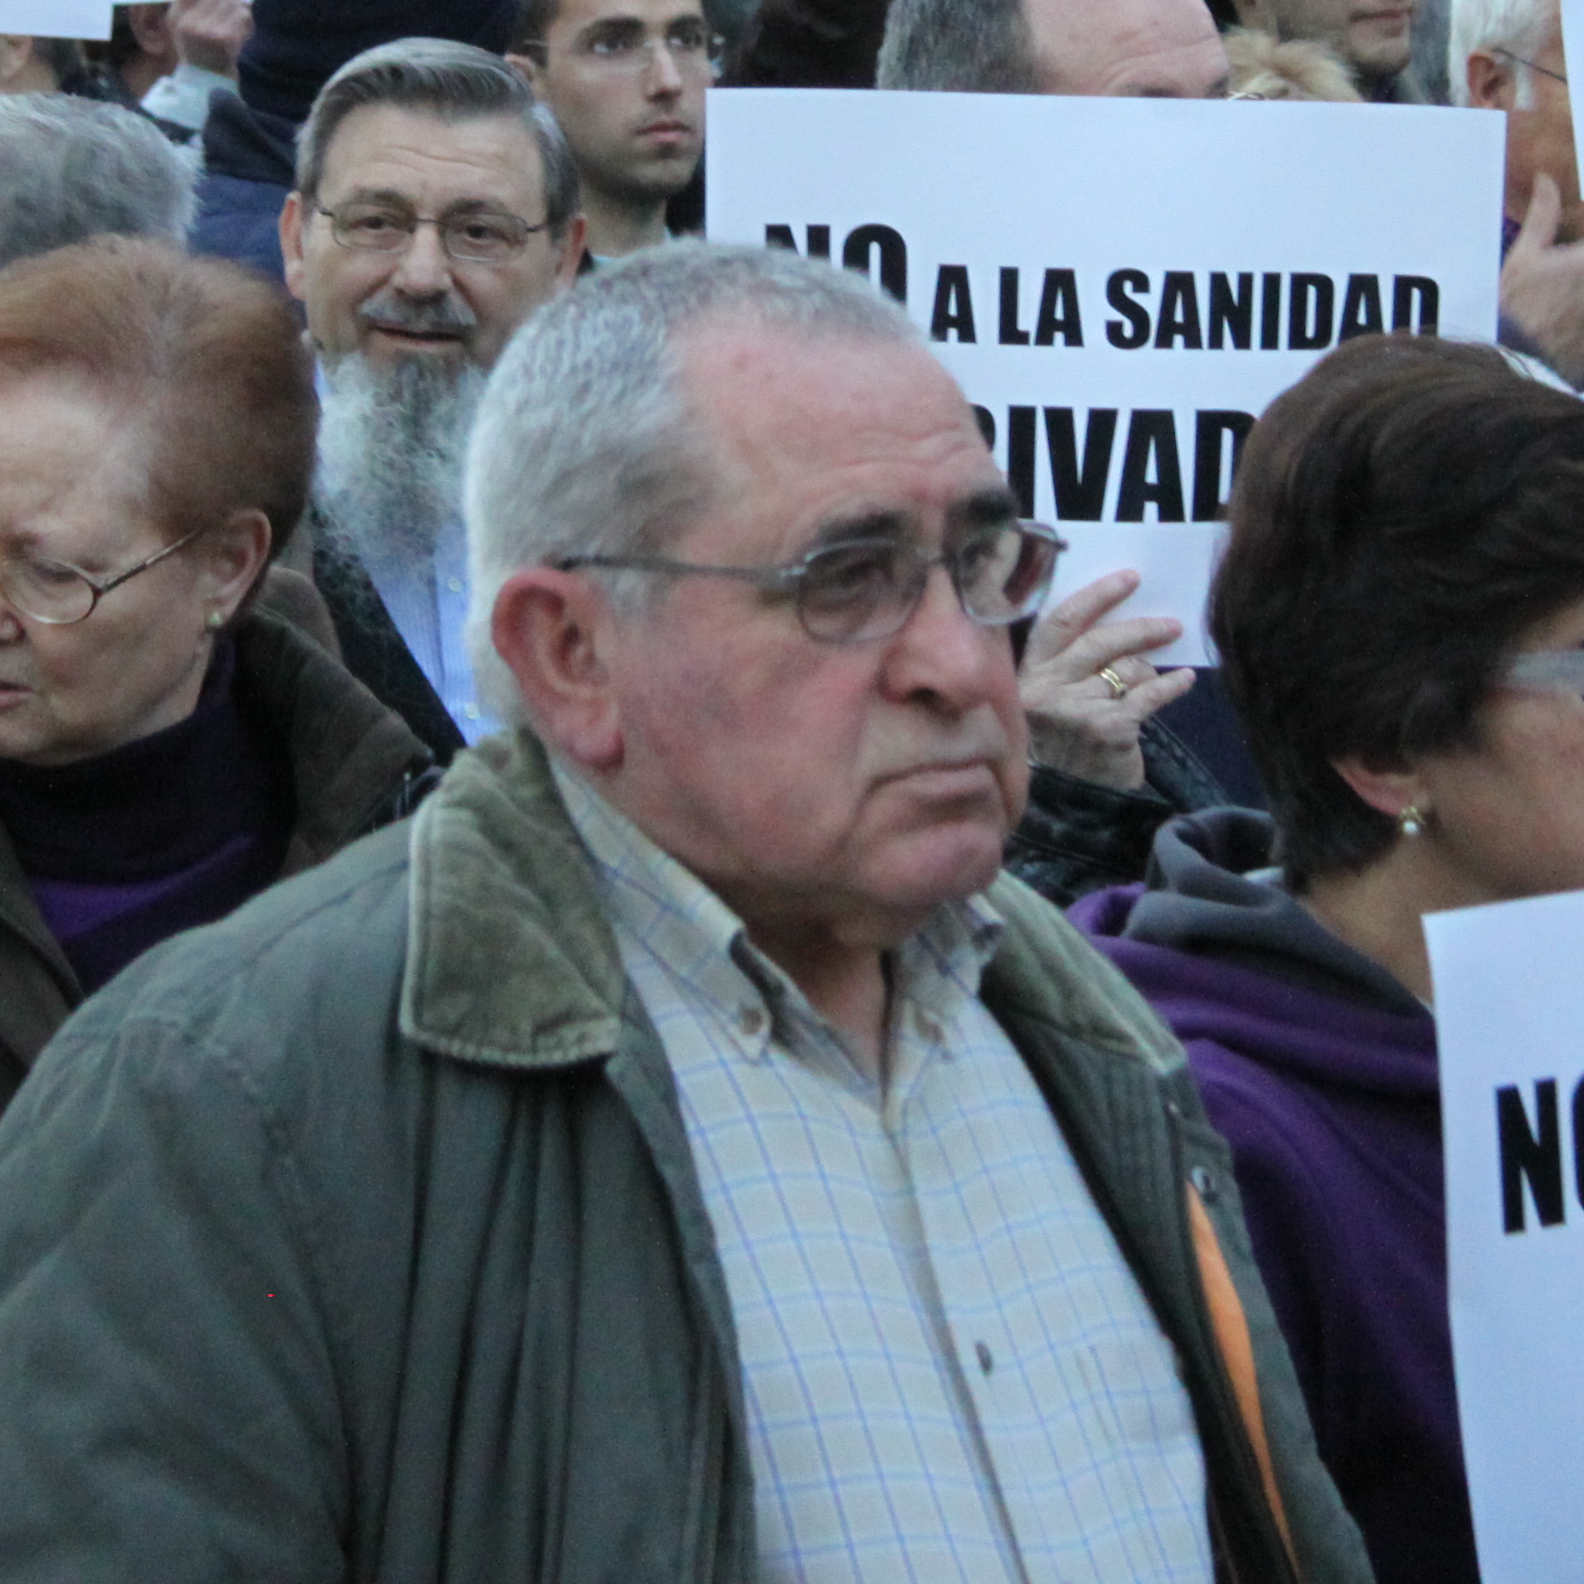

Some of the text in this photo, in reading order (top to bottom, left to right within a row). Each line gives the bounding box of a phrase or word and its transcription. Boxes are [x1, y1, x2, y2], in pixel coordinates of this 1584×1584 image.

[930, 264, 977, 344] A
[998, 266, 1085, 348] LA
[1105, 268, 1441, 351] SANIDAD
